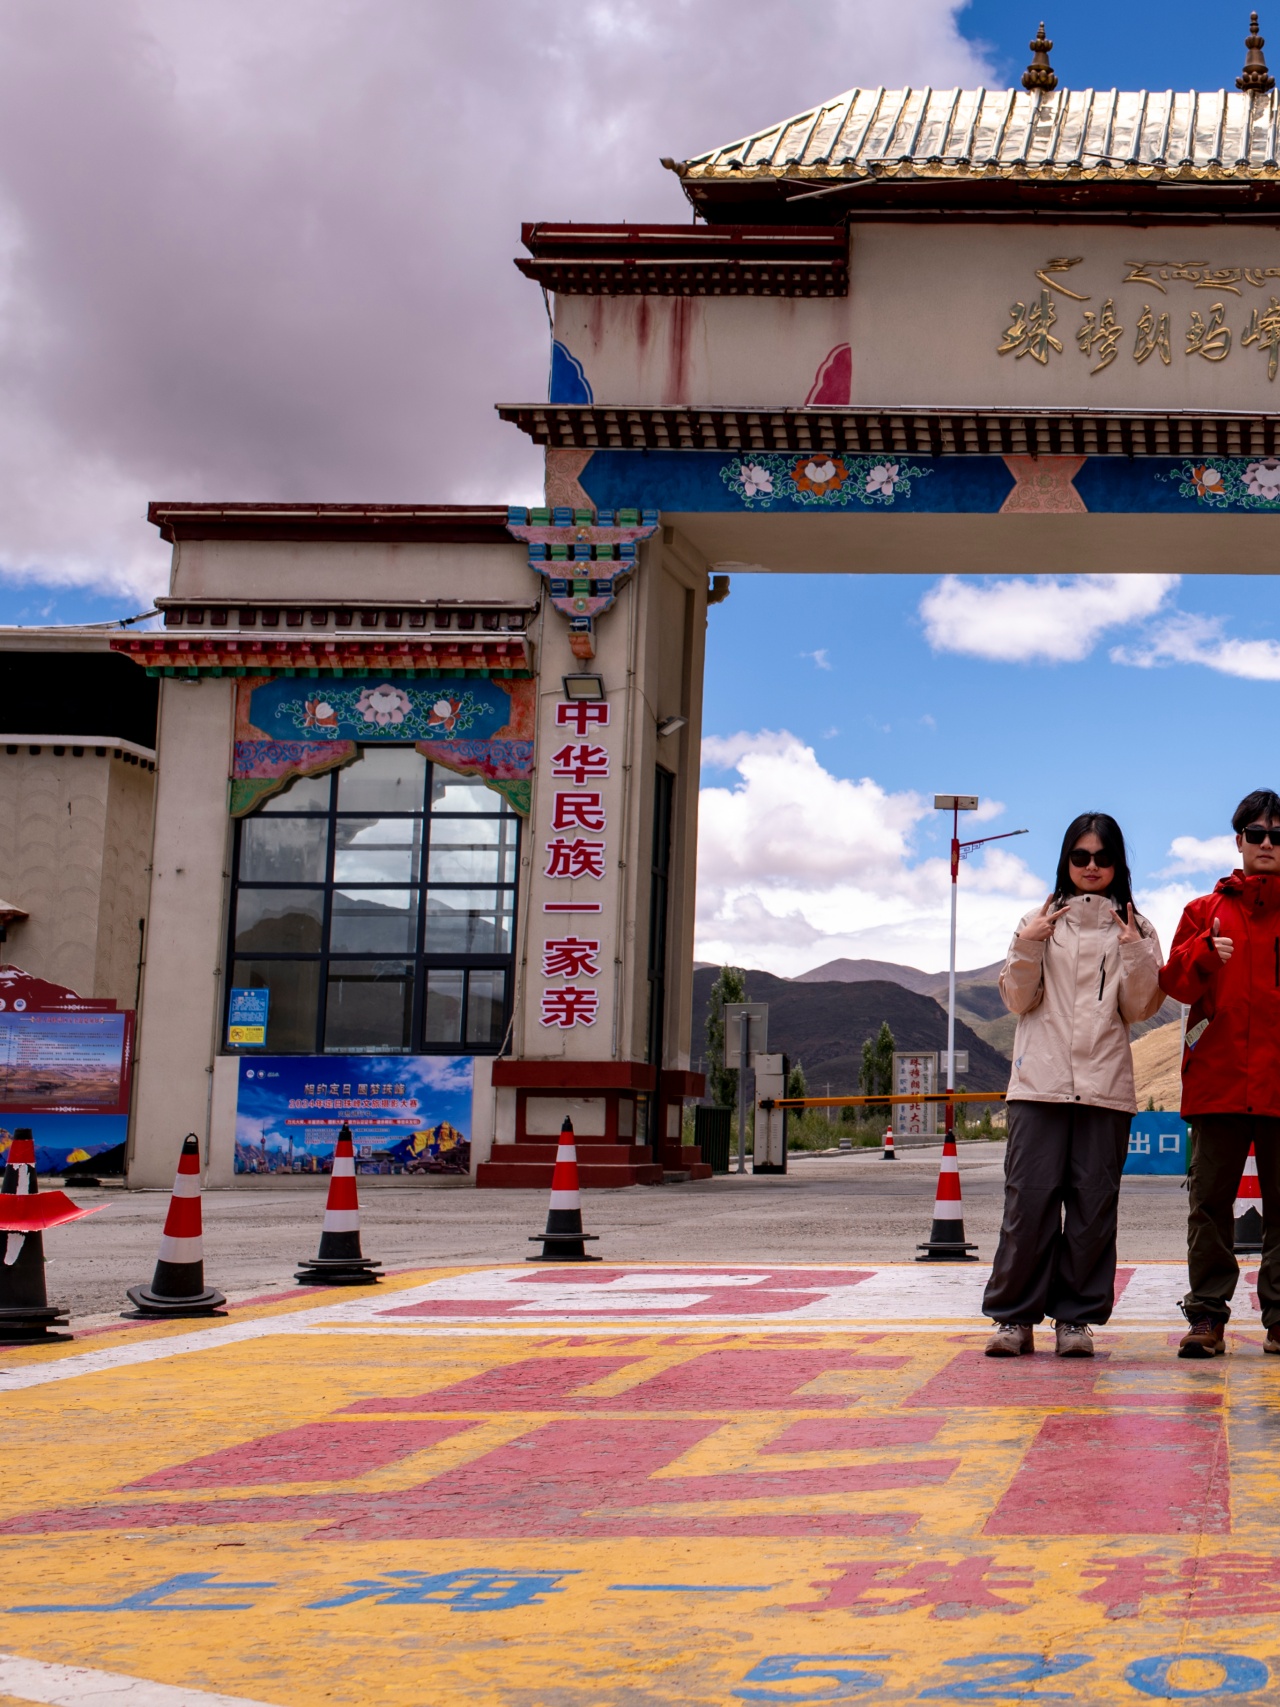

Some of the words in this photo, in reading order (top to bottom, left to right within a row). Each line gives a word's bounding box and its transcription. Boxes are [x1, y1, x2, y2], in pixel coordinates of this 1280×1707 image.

[539, 700, 610, 1029] 中华民族一家亲
[1128, 1131, 1180, 1154] 出口
[526, 1332, 914, 1348] MUST
